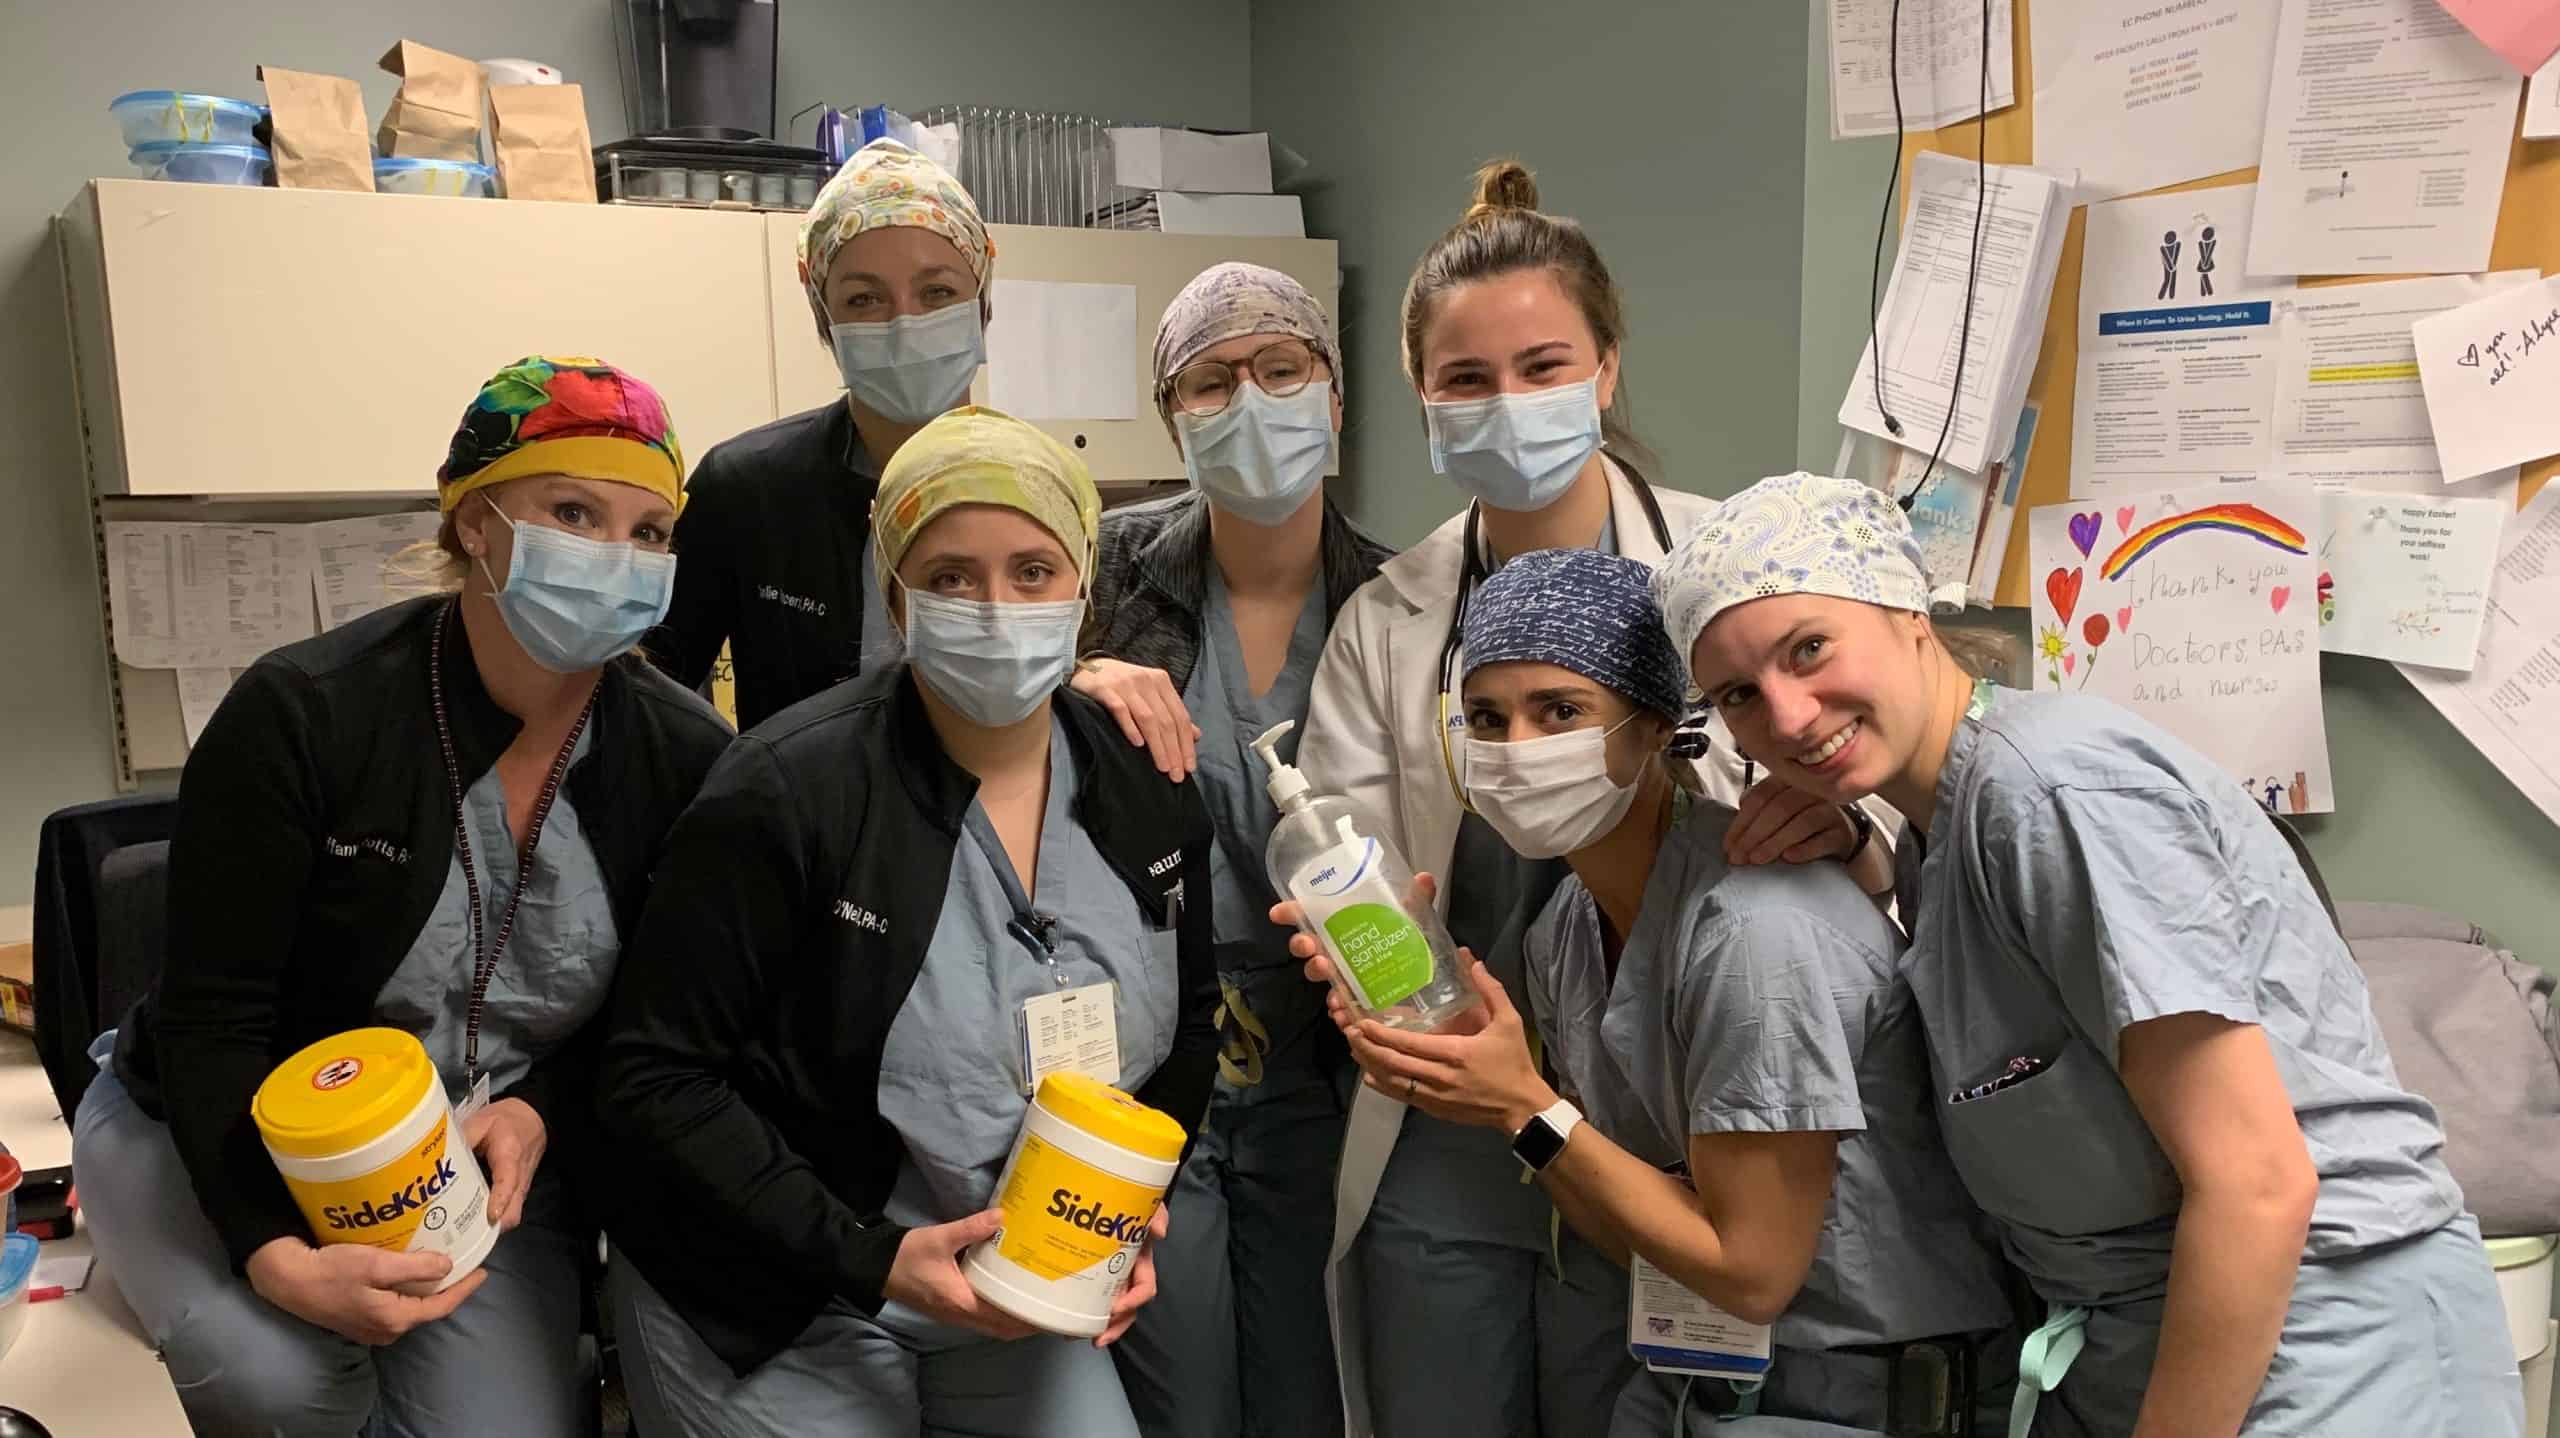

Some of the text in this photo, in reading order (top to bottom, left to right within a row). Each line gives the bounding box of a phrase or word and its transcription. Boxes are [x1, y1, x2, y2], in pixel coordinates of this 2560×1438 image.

[2485, 331, 2507, 361] you
[2401, 508, 2426, 518] Happy
[2422, 527, 2437, 536] you
[2249, 564, 2289, 595] you
[2133, 675, 2184, 702] and
[1309, 864, 1338, 888] meijer
[1342, 921, 1381, 955] hand
[1350, 924, 1411, 968] sanitizer
[323, 1157, 458, 1230] SideKick
